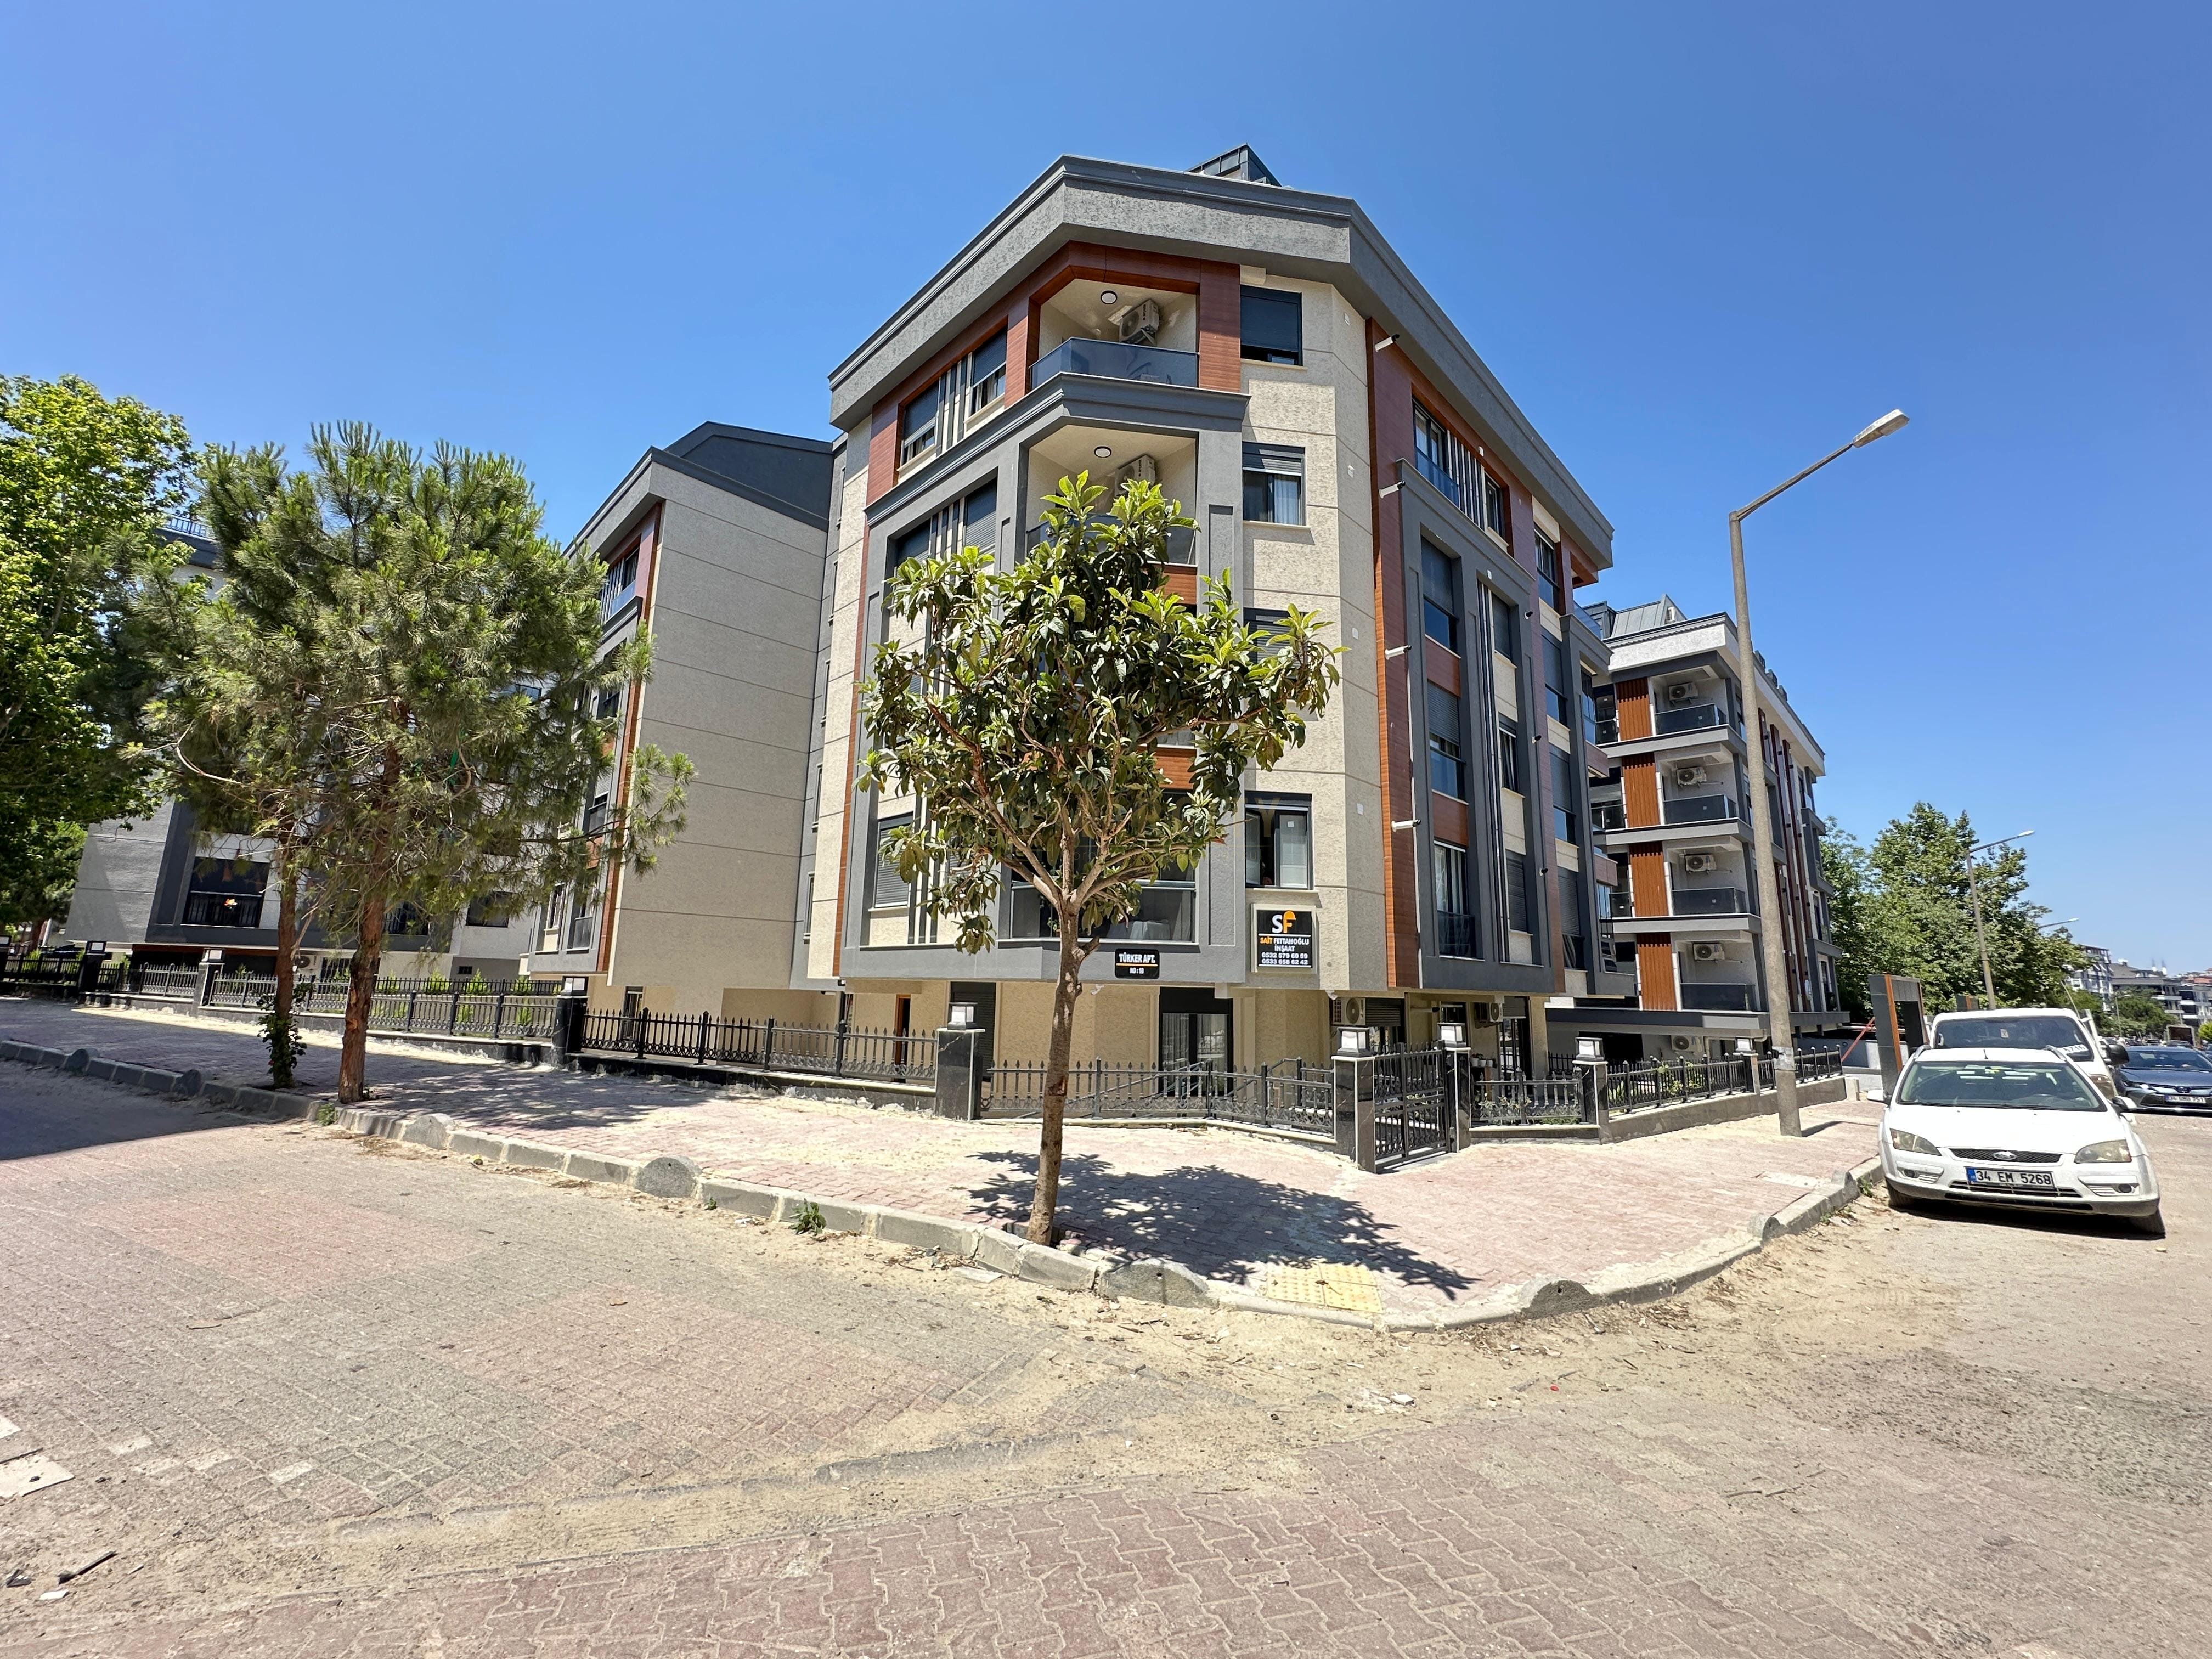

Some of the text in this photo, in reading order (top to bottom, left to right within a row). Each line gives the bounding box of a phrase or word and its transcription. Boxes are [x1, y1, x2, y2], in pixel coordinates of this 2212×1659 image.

[1272, 910, 1296, 934] SF
[1274, 944, 1295, 952] İNŞAAT
[1119, 952, 1155, 963] TÜRKER APT.
[1976, 1171, 1991, 1181] 34
[1997, 1171, 2014, 1183] EM
[2020, 1173, 2051, 1185] 5268
